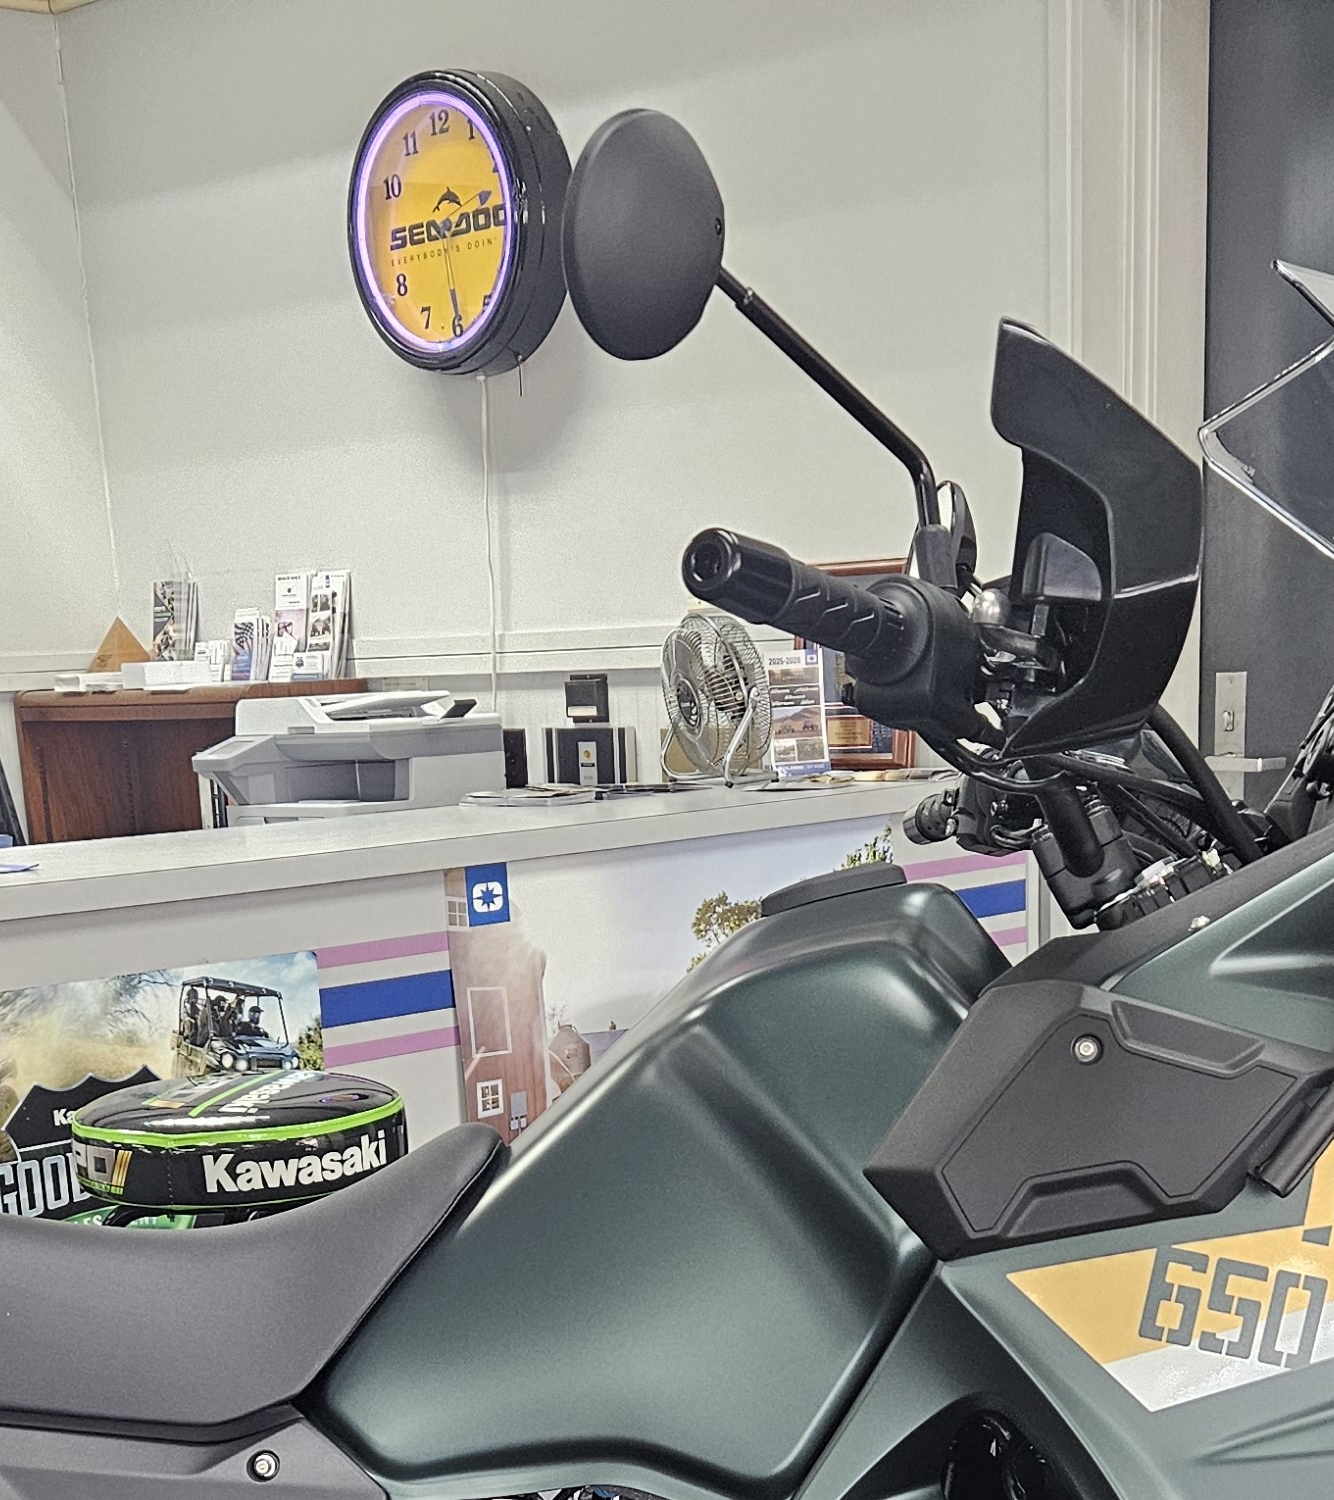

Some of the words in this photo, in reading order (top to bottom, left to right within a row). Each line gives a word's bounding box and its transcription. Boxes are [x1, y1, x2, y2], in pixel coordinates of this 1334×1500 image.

[429, 109, 449, 136] 12
[403, 130, 419, 157] 11
[384, 174, 402, 200] 10
[396, 273, 408, 297] 8
[420, 306, 432, 330] 7
[452, 316, 464, 338] 6
[202, 1131, 388, 1194] Kawasaki
[1138, 1245, 1329, 1369] 650
